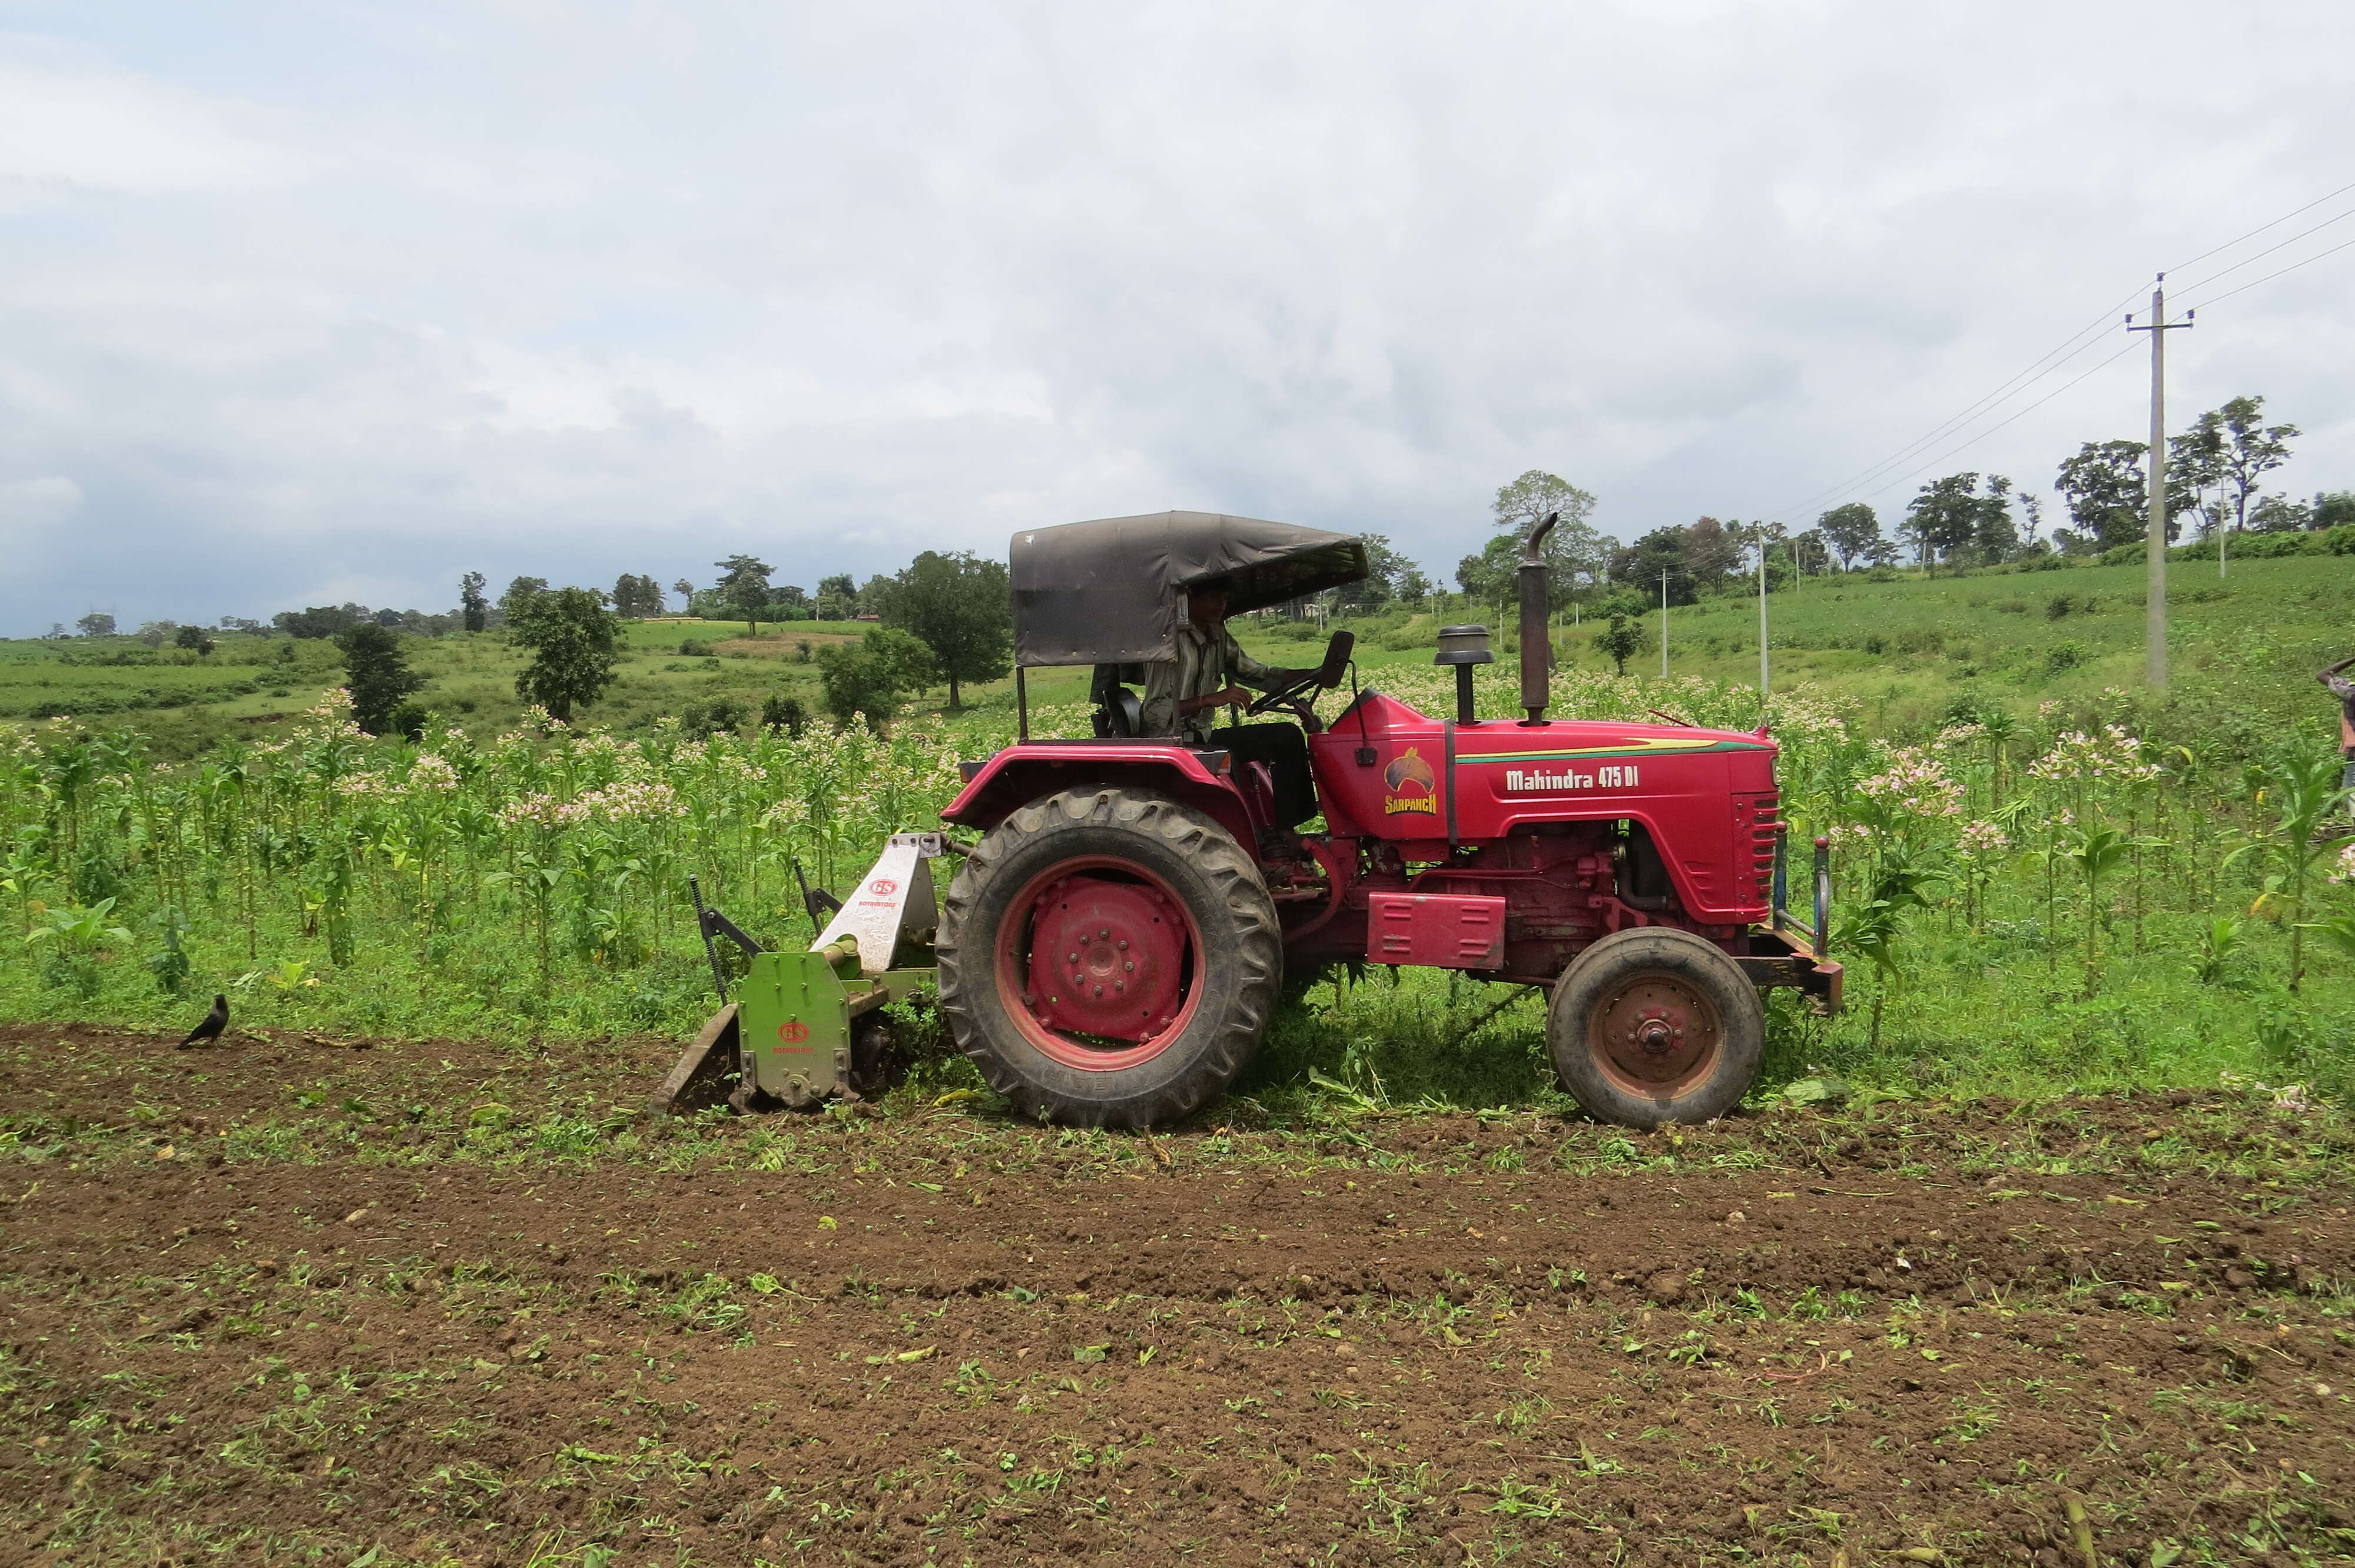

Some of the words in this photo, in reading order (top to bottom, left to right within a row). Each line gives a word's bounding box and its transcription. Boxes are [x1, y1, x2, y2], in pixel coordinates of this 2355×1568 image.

[1506, 769, 1593, 790] Mahindra
[1598, 766, 1621, 788] 475
[1624, 766, 1638, 787] DI
[1385, 794, 1437, 814] SARPANCH
